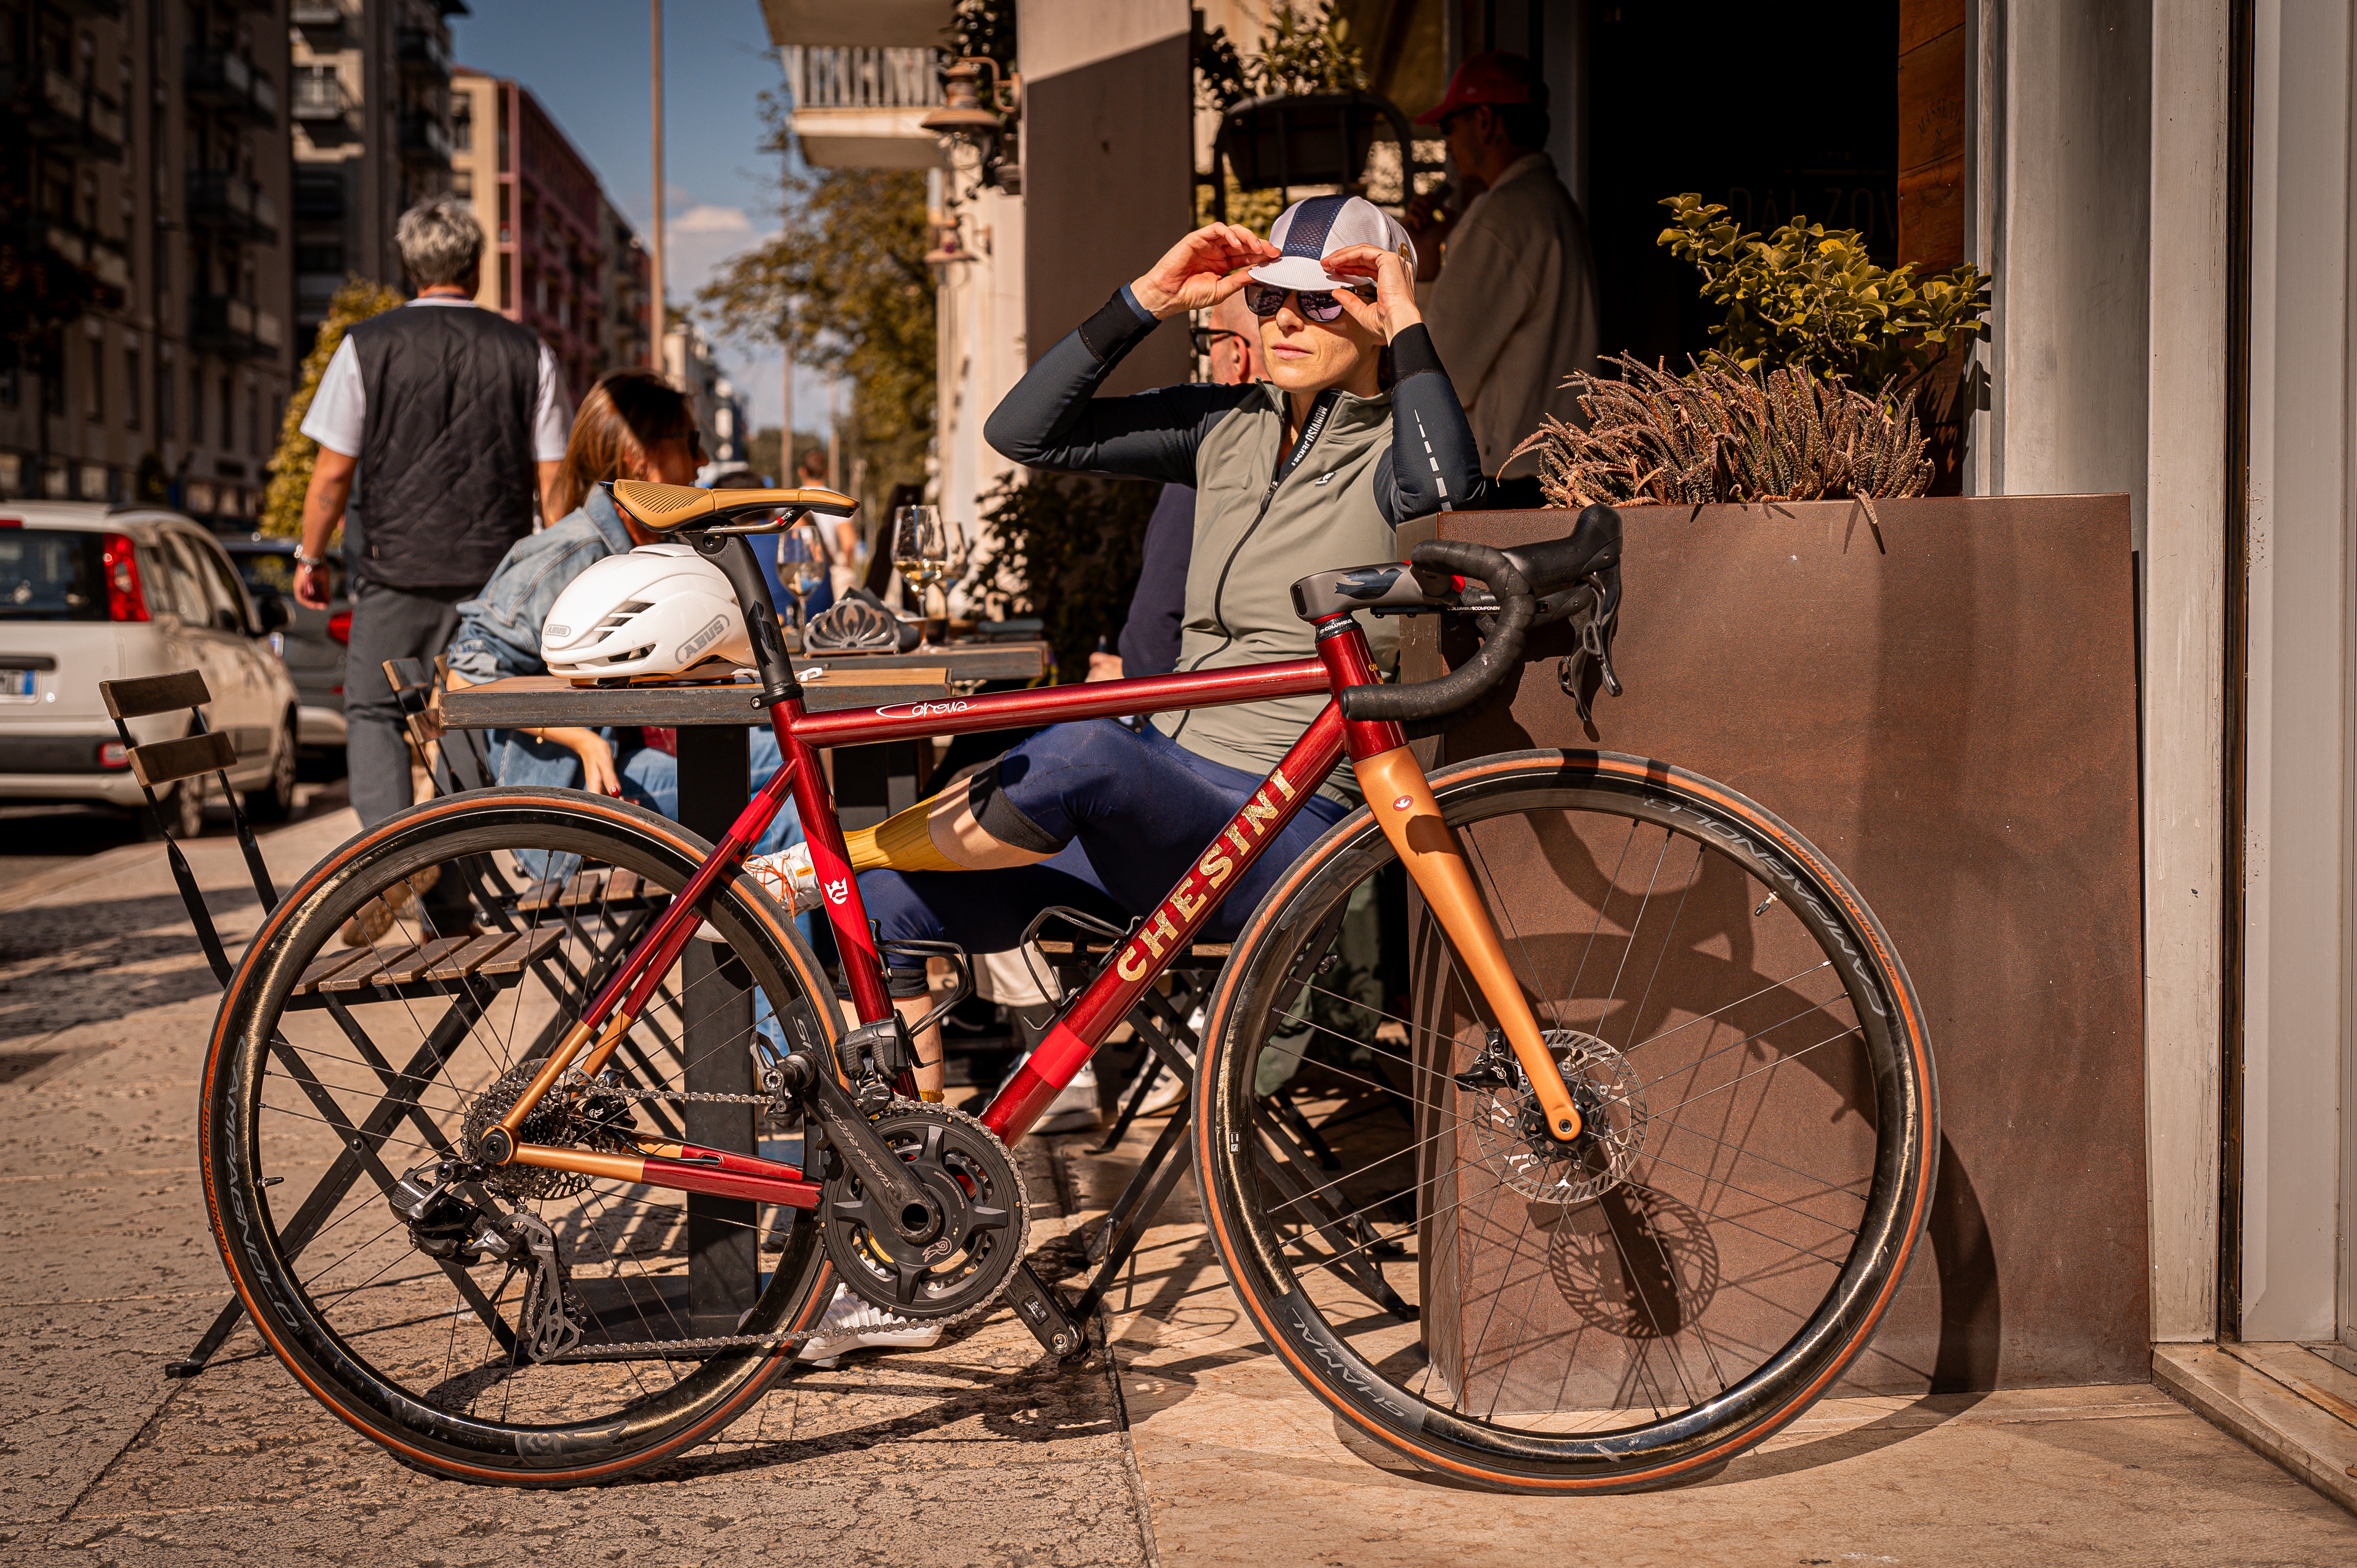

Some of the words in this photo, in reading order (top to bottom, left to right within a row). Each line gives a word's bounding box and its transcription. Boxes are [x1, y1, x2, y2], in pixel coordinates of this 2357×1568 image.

[547, 626, 567, 635] ABUS
[684, 620, 724, 659] ABUS
[1324, 619, 1353, 631] COLUMBUS
[1749, 811, 1773, 830] Continental
[1117, 768, 1296, 982] CHESINI
[1644, 798, 1886, 1016] CAMPAGNOLO
[1780, 835, 1827, 876] GRAND
[1826, 874, 1859, 910] PRIX
[1855, 911, 1886, 957] 5000
[818, 1098, 859, 1147] RECORD
[204, 1158, 216, 1199] PRIX
[225, 1035, 300, 1327] CAMPAGNOLO
[857, 1149, 895, 1189] SUPER
[211, 1200, 230, 1254] GRAND
[229, 1263, 243, 1288] Continental
[1291, 1307, 1411, 1417] SHAMAL
[1326, 1343, 1372, 1382] CARBON
